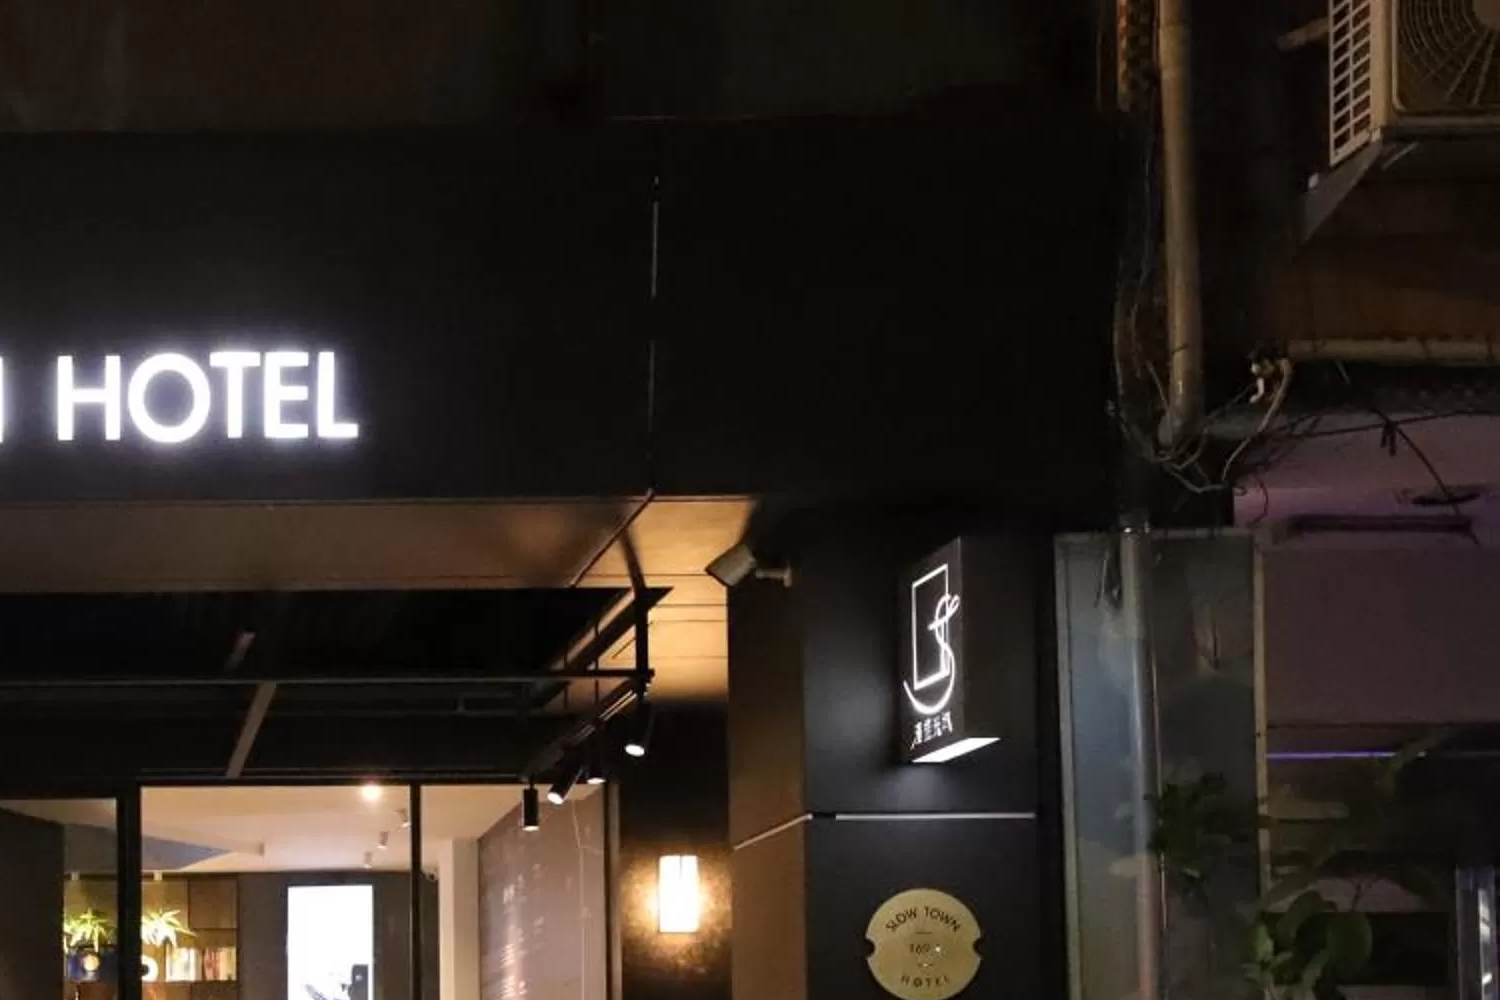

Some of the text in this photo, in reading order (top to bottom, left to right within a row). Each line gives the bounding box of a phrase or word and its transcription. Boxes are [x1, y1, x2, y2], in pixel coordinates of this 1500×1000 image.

[56, 351, 360, 444] HOTEL
[885, 905, 961, 932] SLOW TOWN
